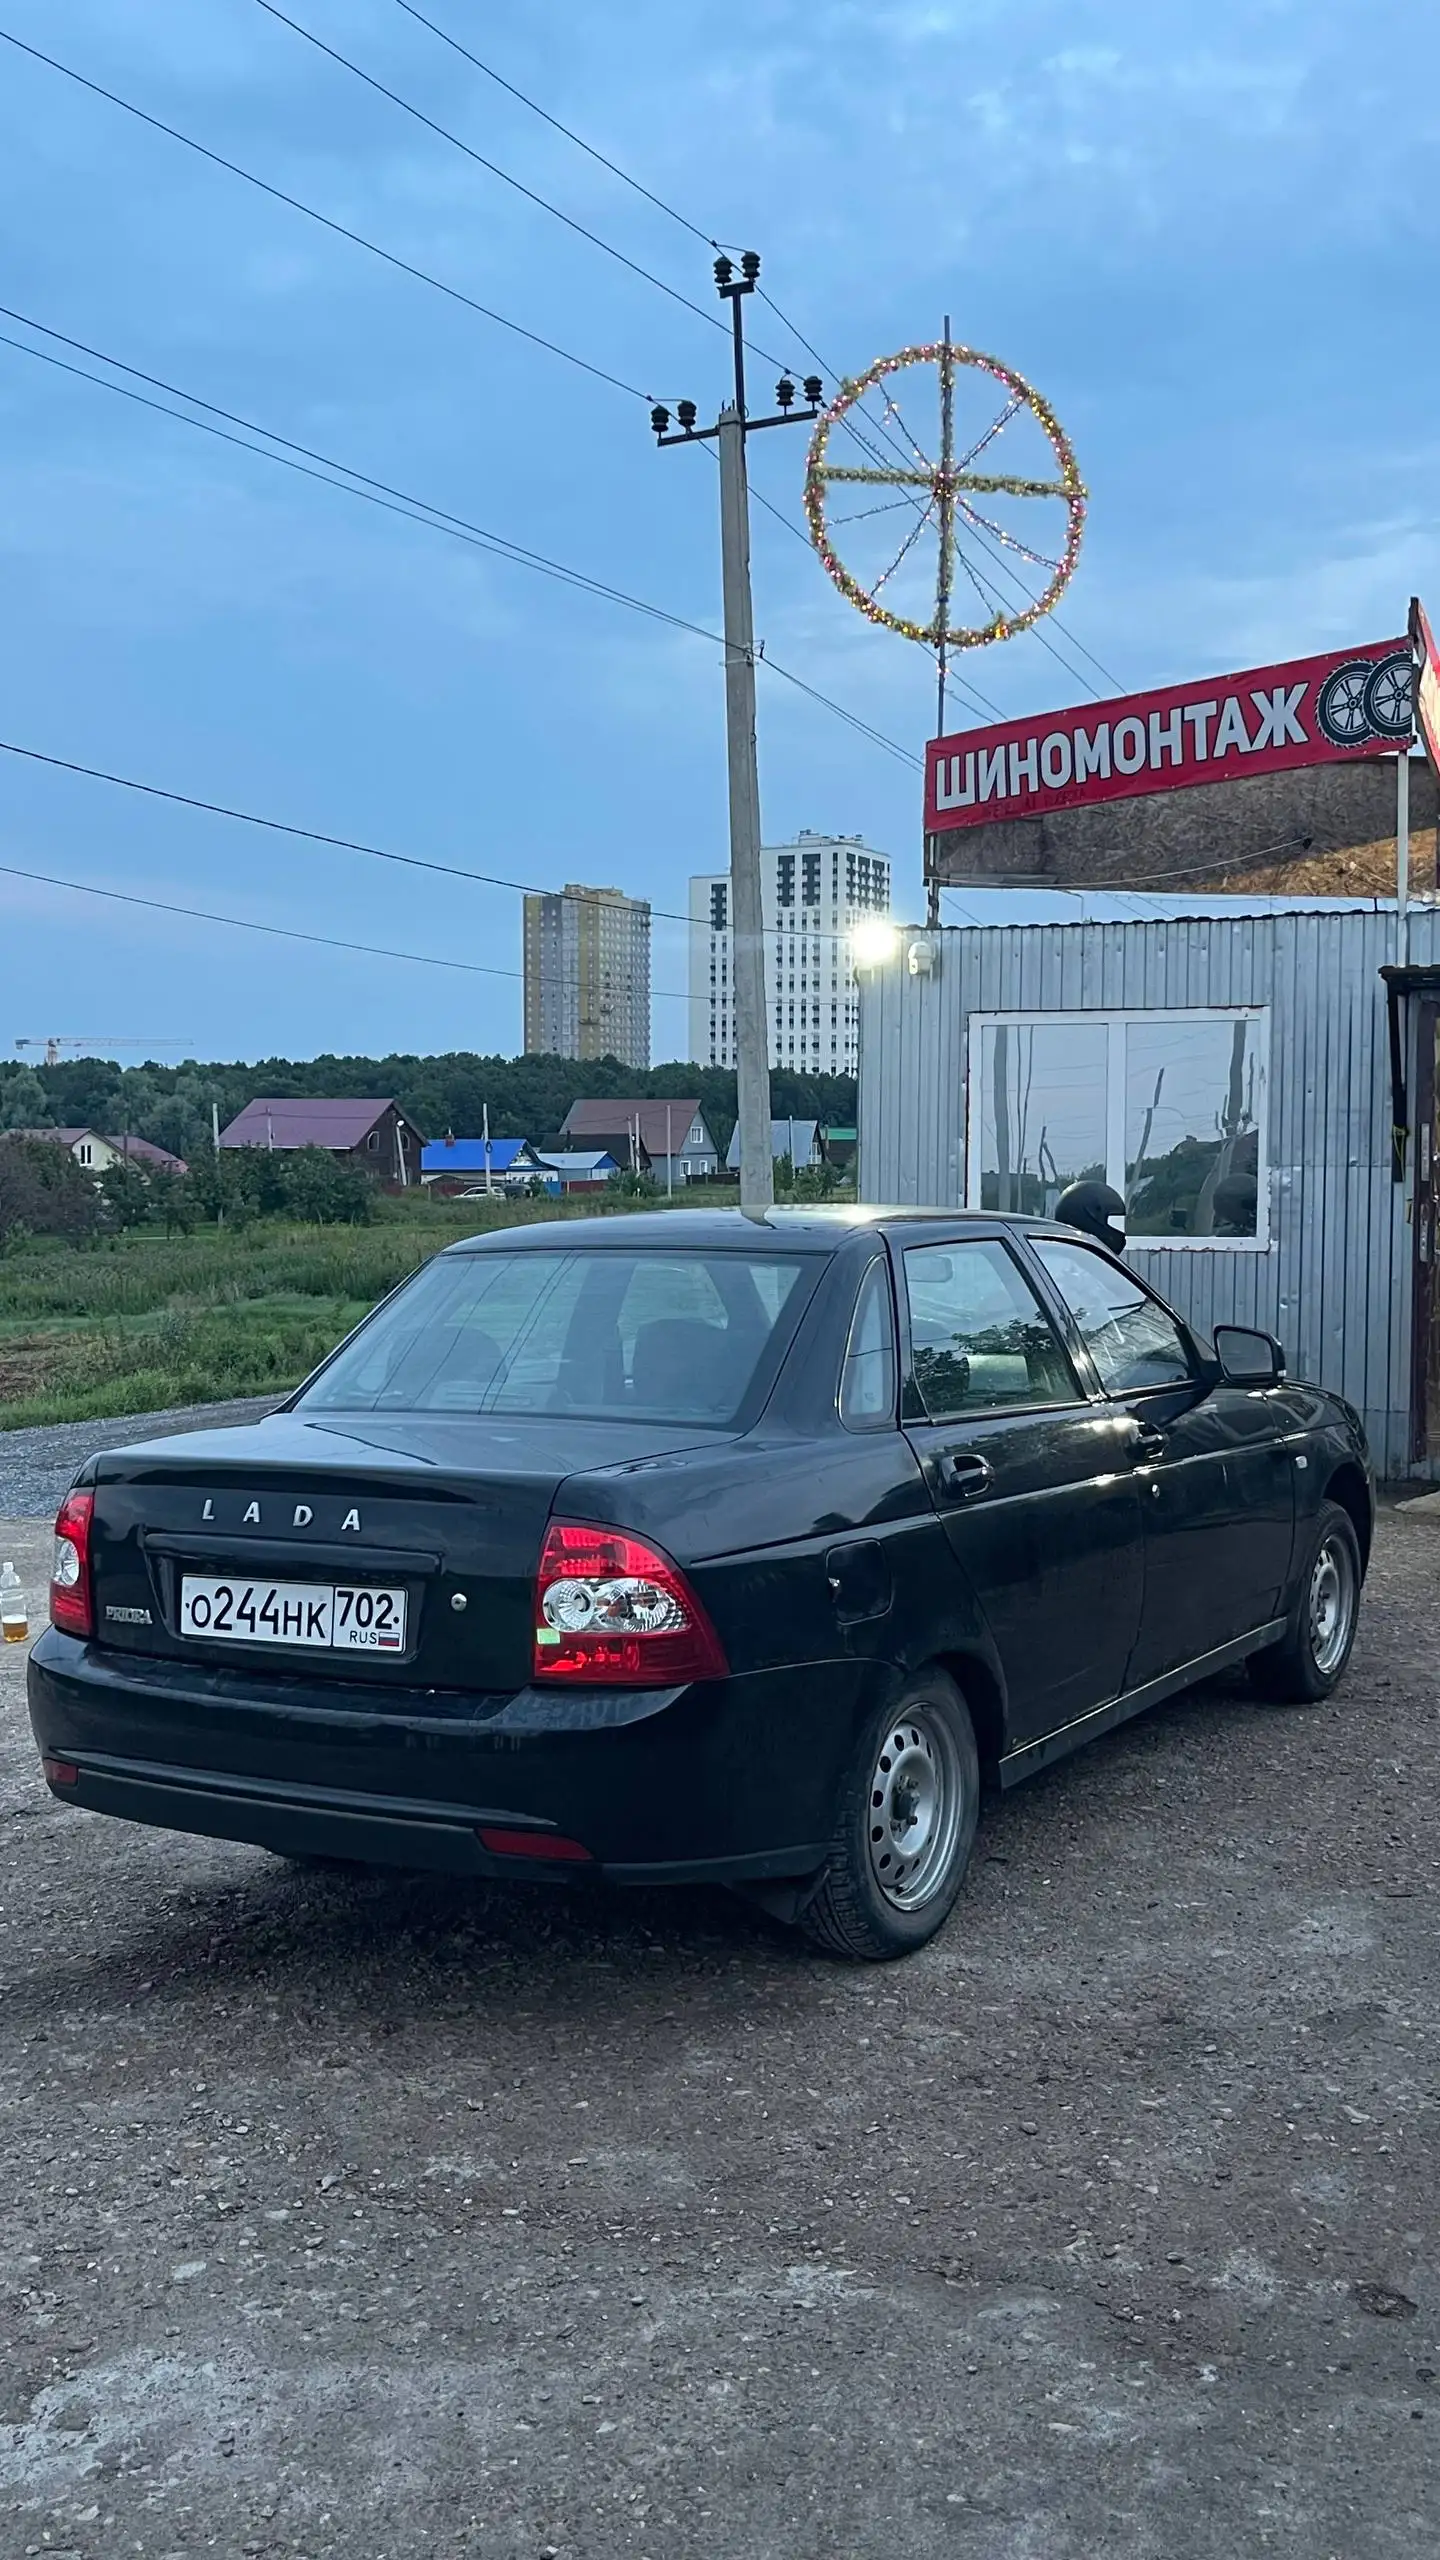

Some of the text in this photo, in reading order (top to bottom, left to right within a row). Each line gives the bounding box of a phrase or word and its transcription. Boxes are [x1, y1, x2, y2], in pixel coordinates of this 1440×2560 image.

[936, 682, 1310, 811] ШИНОМОНТАЖ
[202, 1499, 360, 1531] LADA
[104, 1605, 153, 1625] PRIORA
[337, 1590, 393, 1630] 702
[350, 1630, 377, 1645] RUS
